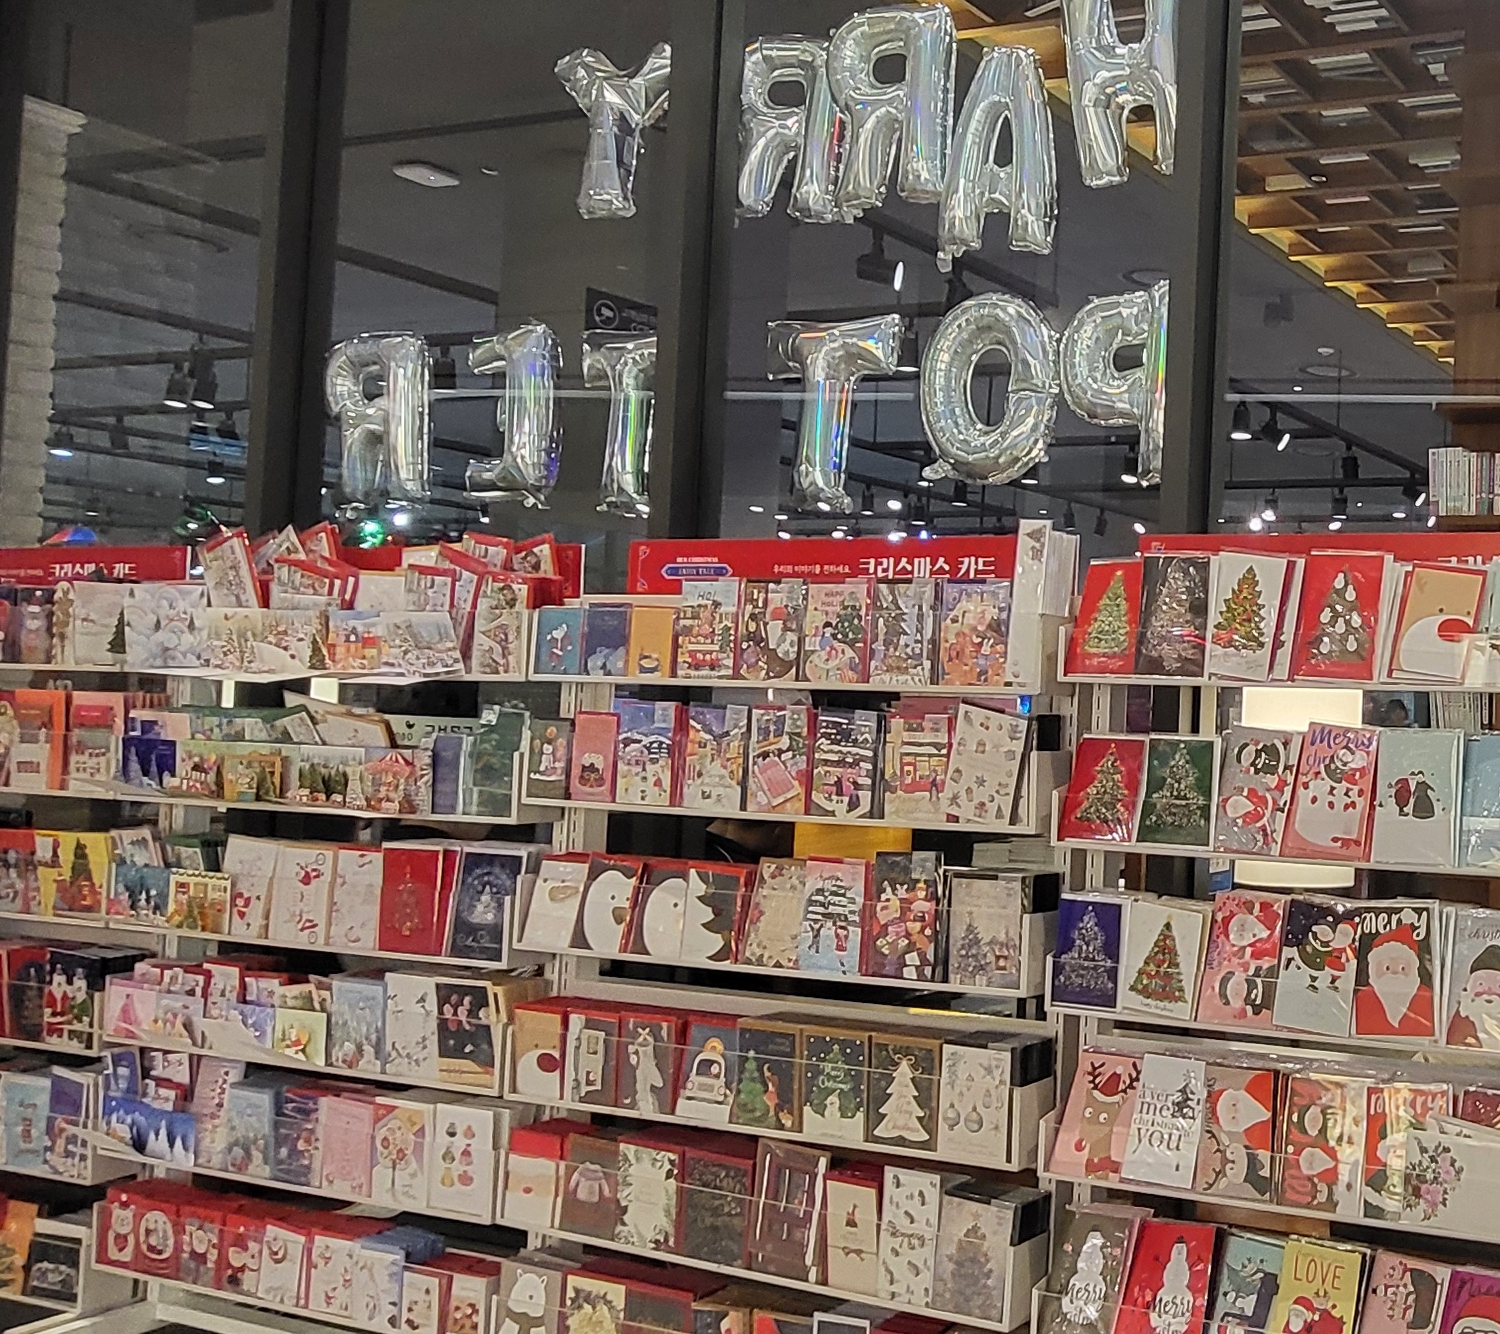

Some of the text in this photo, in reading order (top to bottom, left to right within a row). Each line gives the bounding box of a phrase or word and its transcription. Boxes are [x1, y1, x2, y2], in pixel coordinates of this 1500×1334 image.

[856, 555, 997, 580] 크리스마스 카드
[1132, 1127, 1183, 1155] you
[1293, 1251, 1347, 1291] LOVE
